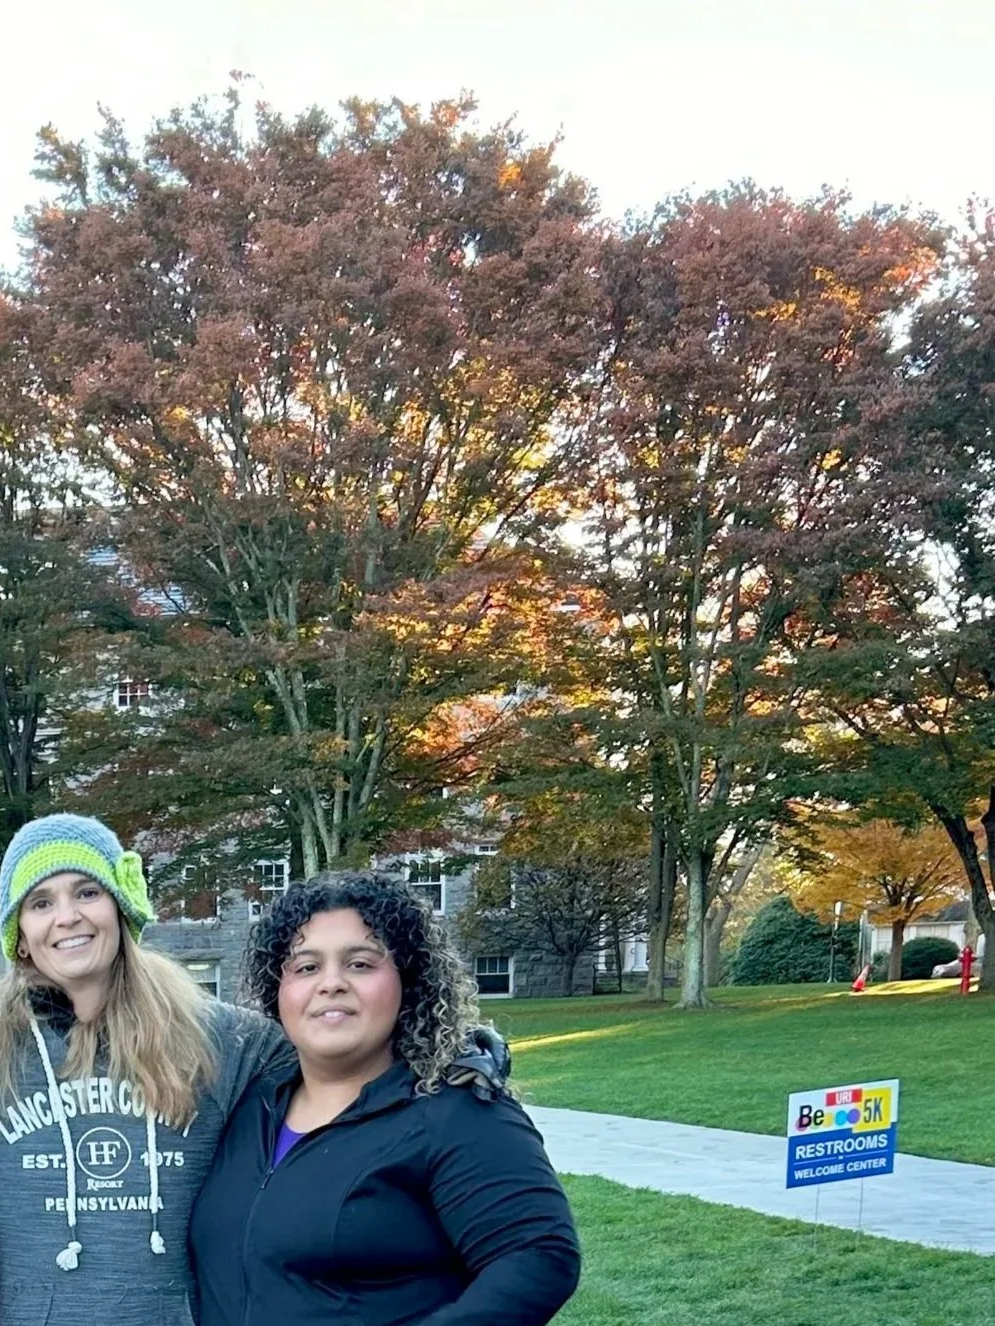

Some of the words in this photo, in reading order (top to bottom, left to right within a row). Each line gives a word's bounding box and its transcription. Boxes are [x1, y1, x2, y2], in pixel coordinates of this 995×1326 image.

[835, 1090, 853, 1104] URI
[798, 1104, 825, 1129] Be
[863, 1097, 883, 1123] 5K
[795, 1134, 888, 1159] RESTROOMS
[22, 1154, 66, 1169] EST.
[793, 1163, 845, 1180] WELCOME
[846, 1158, 887, 1172] CENTER
[45, 1196, 165, 1211] PENSYLVANA
